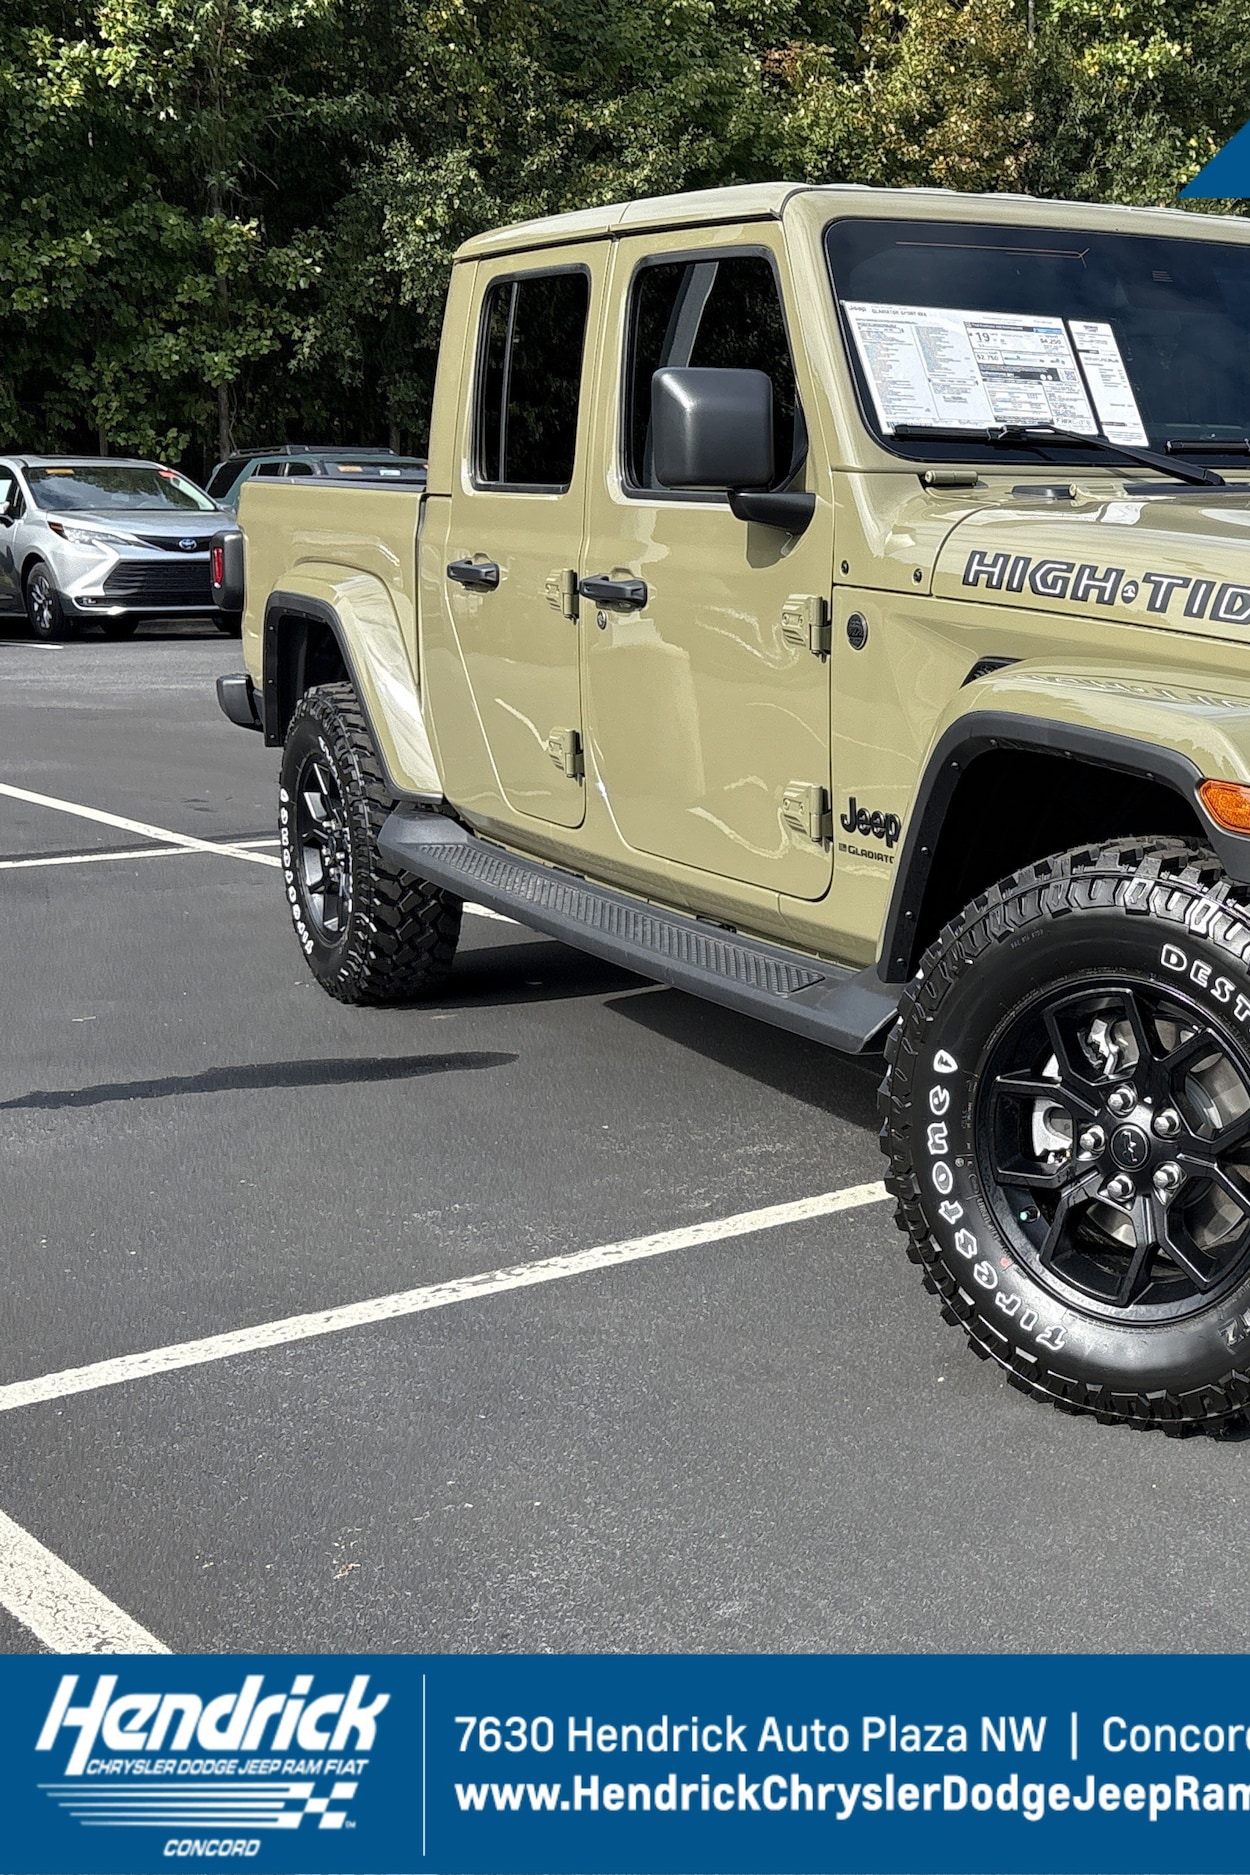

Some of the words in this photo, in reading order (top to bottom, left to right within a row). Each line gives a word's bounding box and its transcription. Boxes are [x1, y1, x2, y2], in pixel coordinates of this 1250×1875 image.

[975, 331, 990, 342] 19
[962, 550, 1126, 606] HIGH
[840, 796, 902, 849] Jeep
[926, 1084, 1068, 1352] Firestone
